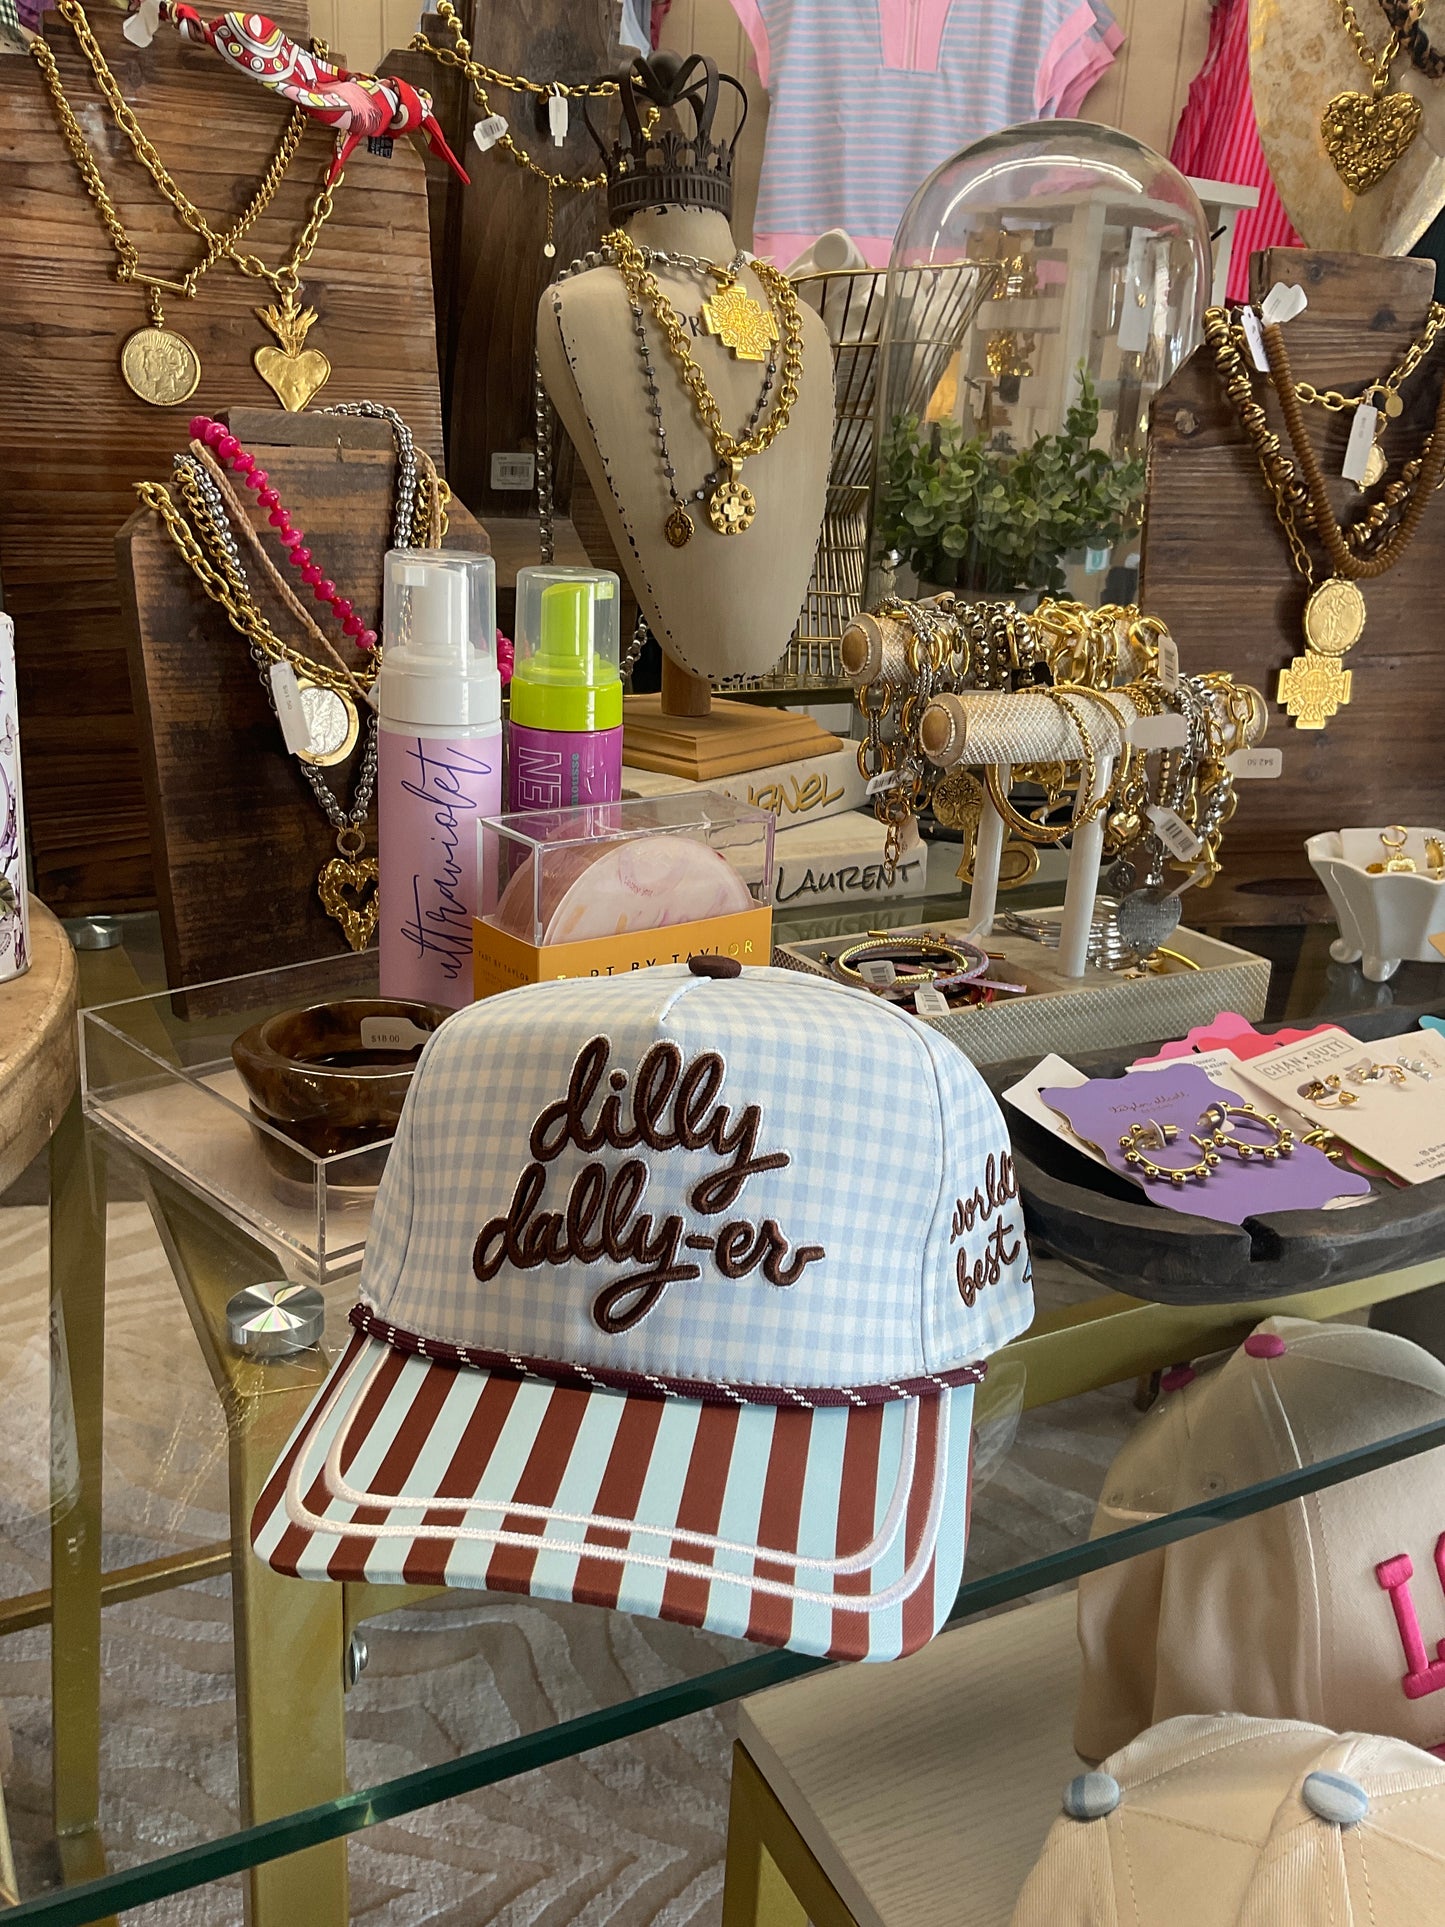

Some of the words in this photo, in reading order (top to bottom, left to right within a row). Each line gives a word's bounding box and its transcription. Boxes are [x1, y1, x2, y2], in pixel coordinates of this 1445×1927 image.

[401, 737, 492, 979] ultraviolet
[775, 859, 921, 903] LAURENT
[529, 1033, 791, 1216] dilly
[1262, 1056, 1302, 1077] CHAN
[473, 1158, 826, 1334] dally-er
[956, 1213, 1022, 1308] best
